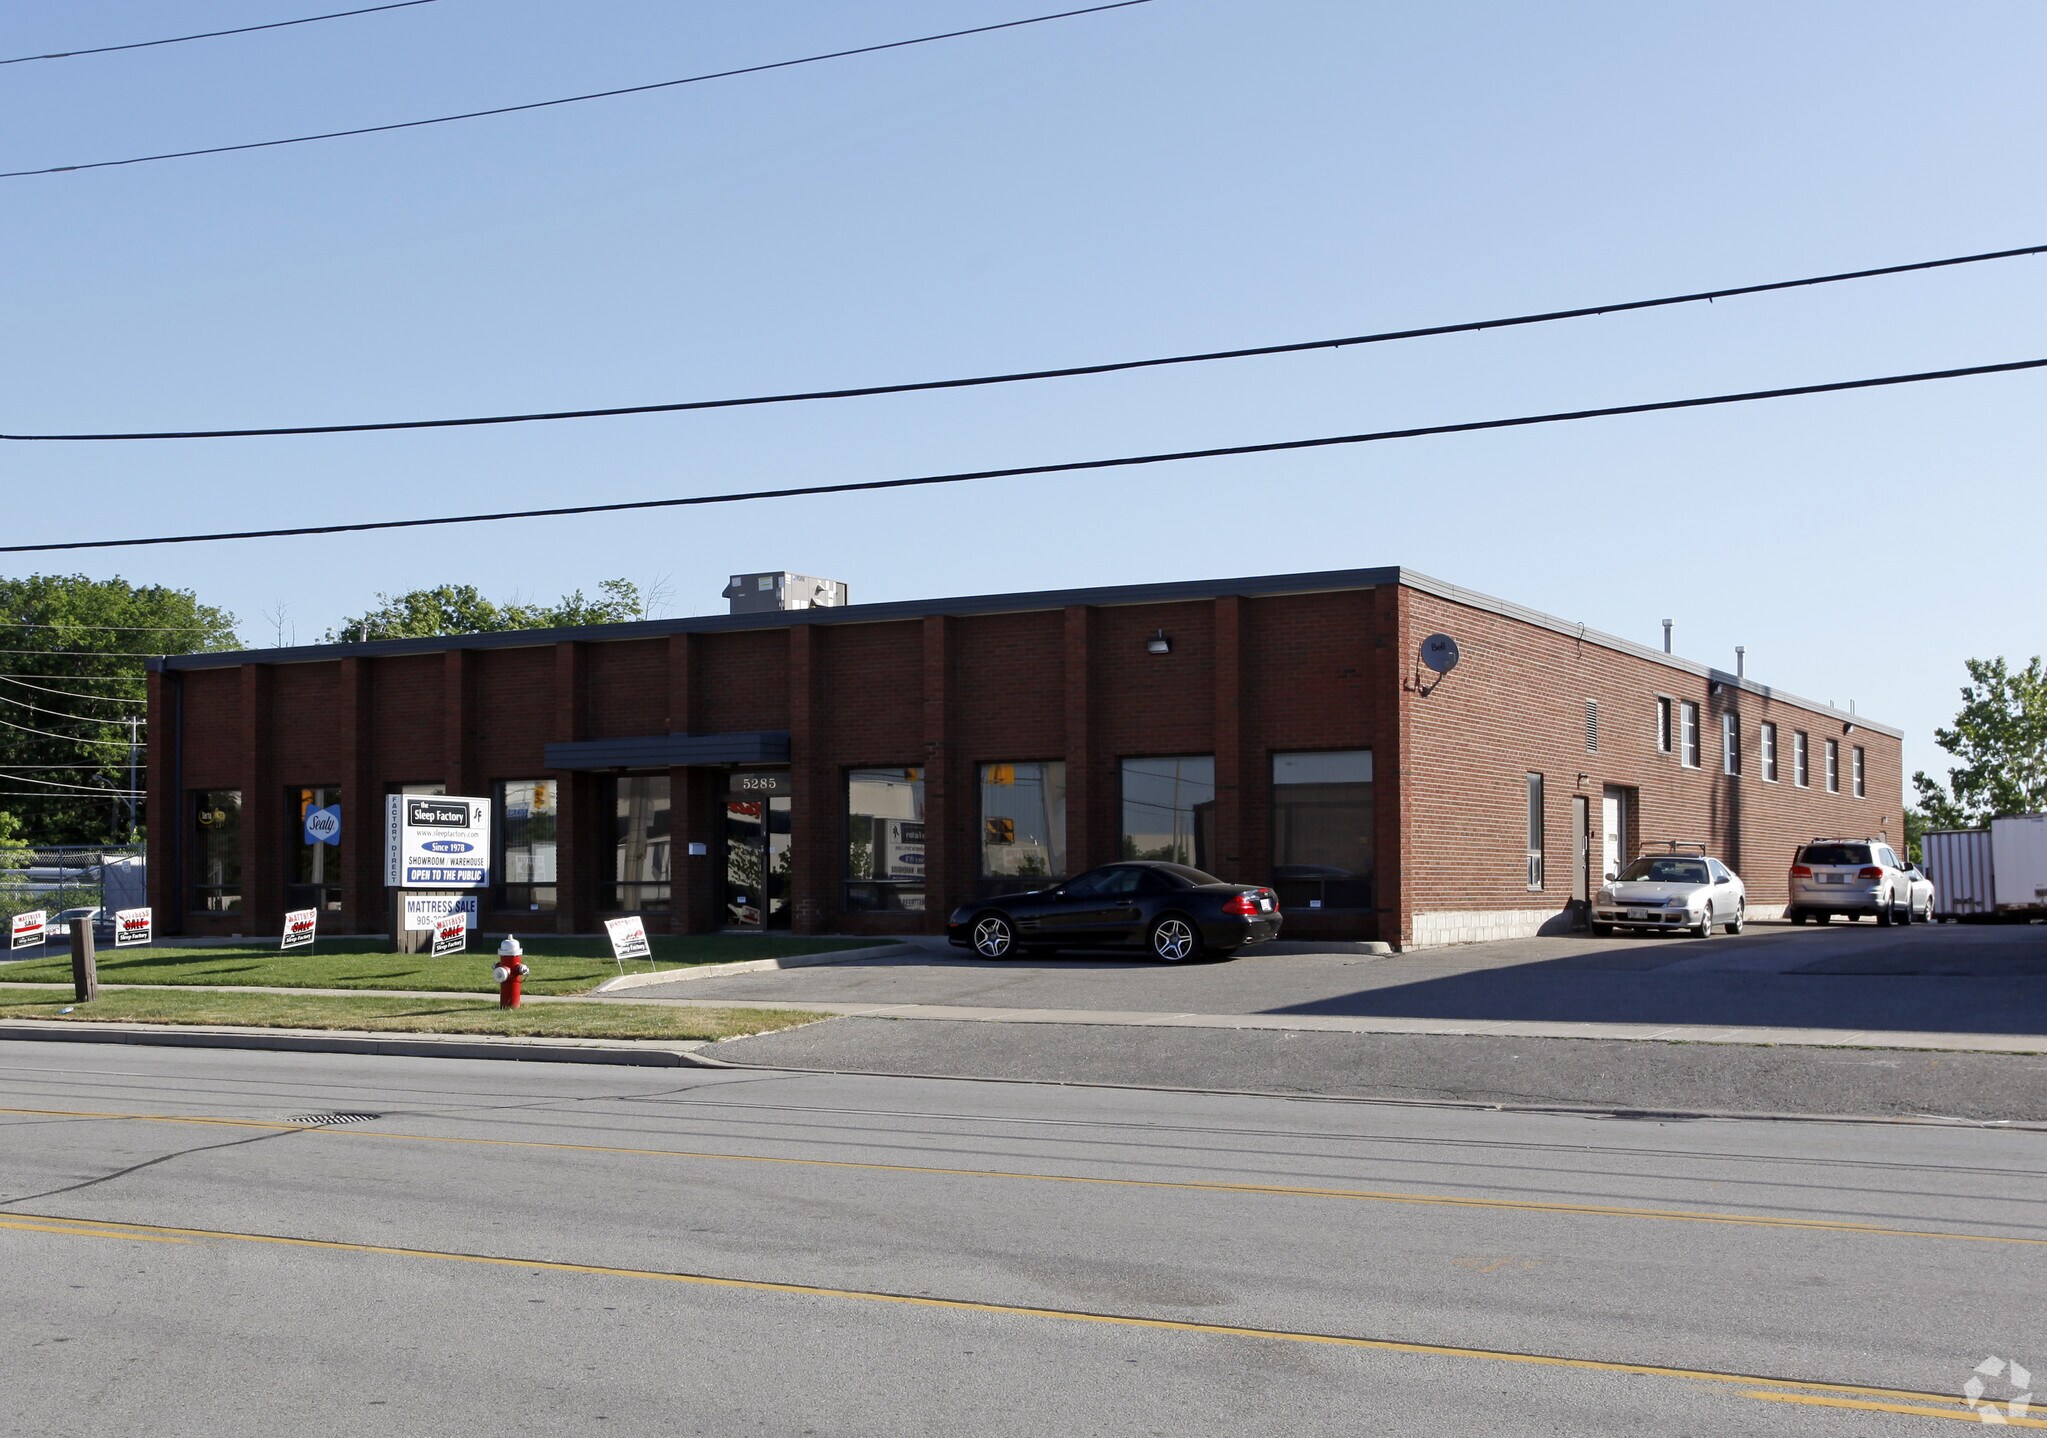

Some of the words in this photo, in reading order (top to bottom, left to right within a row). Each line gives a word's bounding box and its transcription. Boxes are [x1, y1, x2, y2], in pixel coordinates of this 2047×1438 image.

[1431, 641, 1446, 651] Bell
[743, 778, 777, 789] 5285
[414, 808, 435, 823] Sleep
[436, 810, 464, 824] Factory
[309, 815, 335, 834] Sealy
[416, 828, 479, 838] www.sleepfactory.com
[431, 842, 449, 852] Since
[450, 843, 465, 852] 1978
[408, 855, 445, 866] SHOWROOM
[450, 857, 484, 867] WAREHOUSE
[411, 869, 431, 880] OPEN
[432, 869, 442, 880] TO
[443, 870, 457, 881] THE
[457, 870, 482, 881] PUBLIC
[407, 900, 453, 913] MATTRESS
[455, 900, 476, 913] SALE
[125, 918, 144, 930] SALE
[437, 915, 465, 929] MATTRESS
[448, 940, 462, 948] Factory
